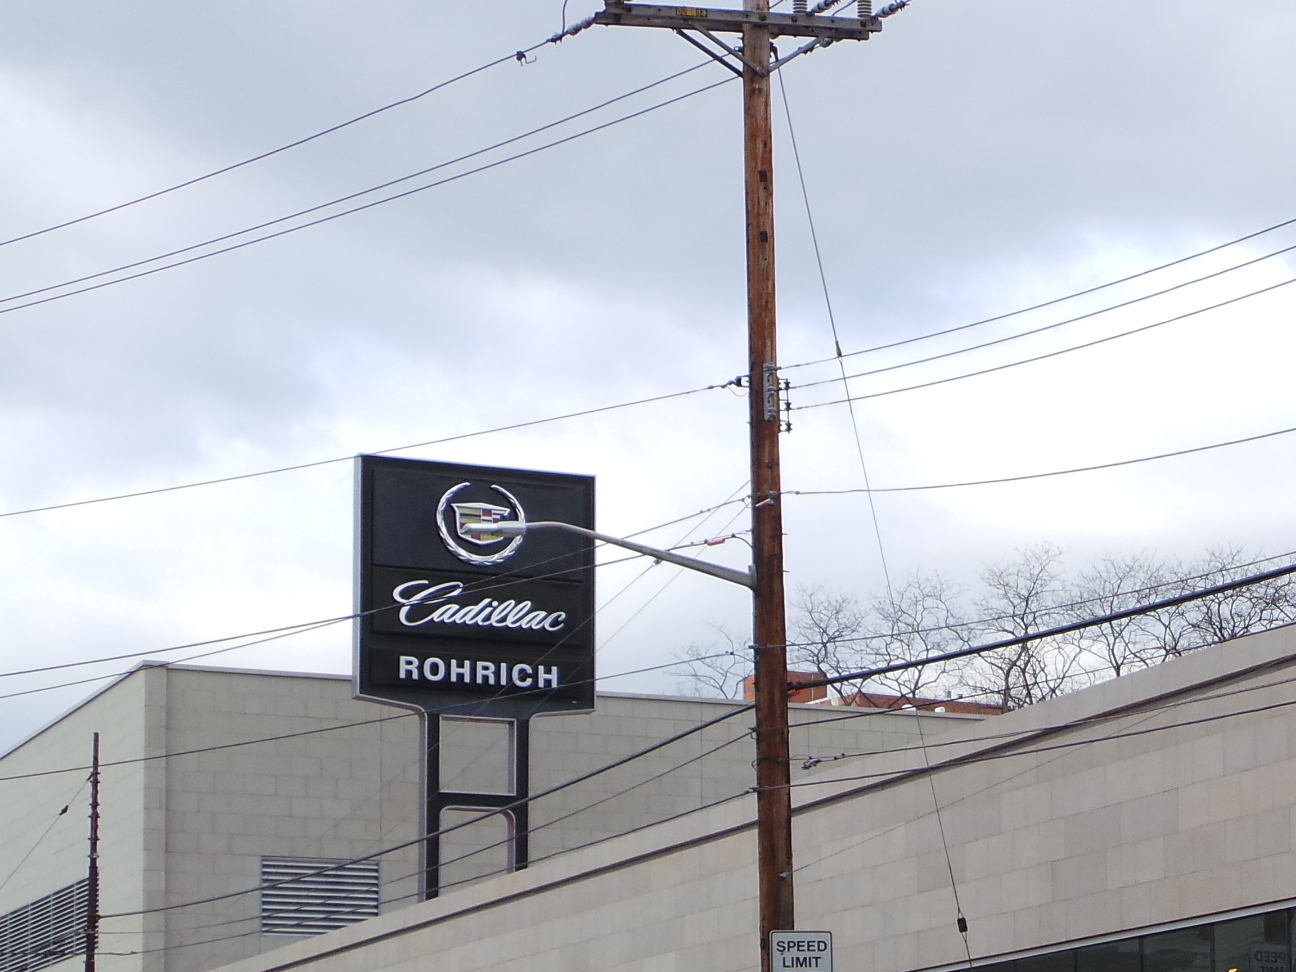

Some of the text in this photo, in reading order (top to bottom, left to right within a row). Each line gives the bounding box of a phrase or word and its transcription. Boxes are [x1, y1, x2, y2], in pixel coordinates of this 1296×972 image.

[393, 580, 566, 631] Cadillac
[399, 655, 559, 688] ROHRICH
[776, 940, 827, 953] SPEED
[782, 956, 822, 968] LIMIT
